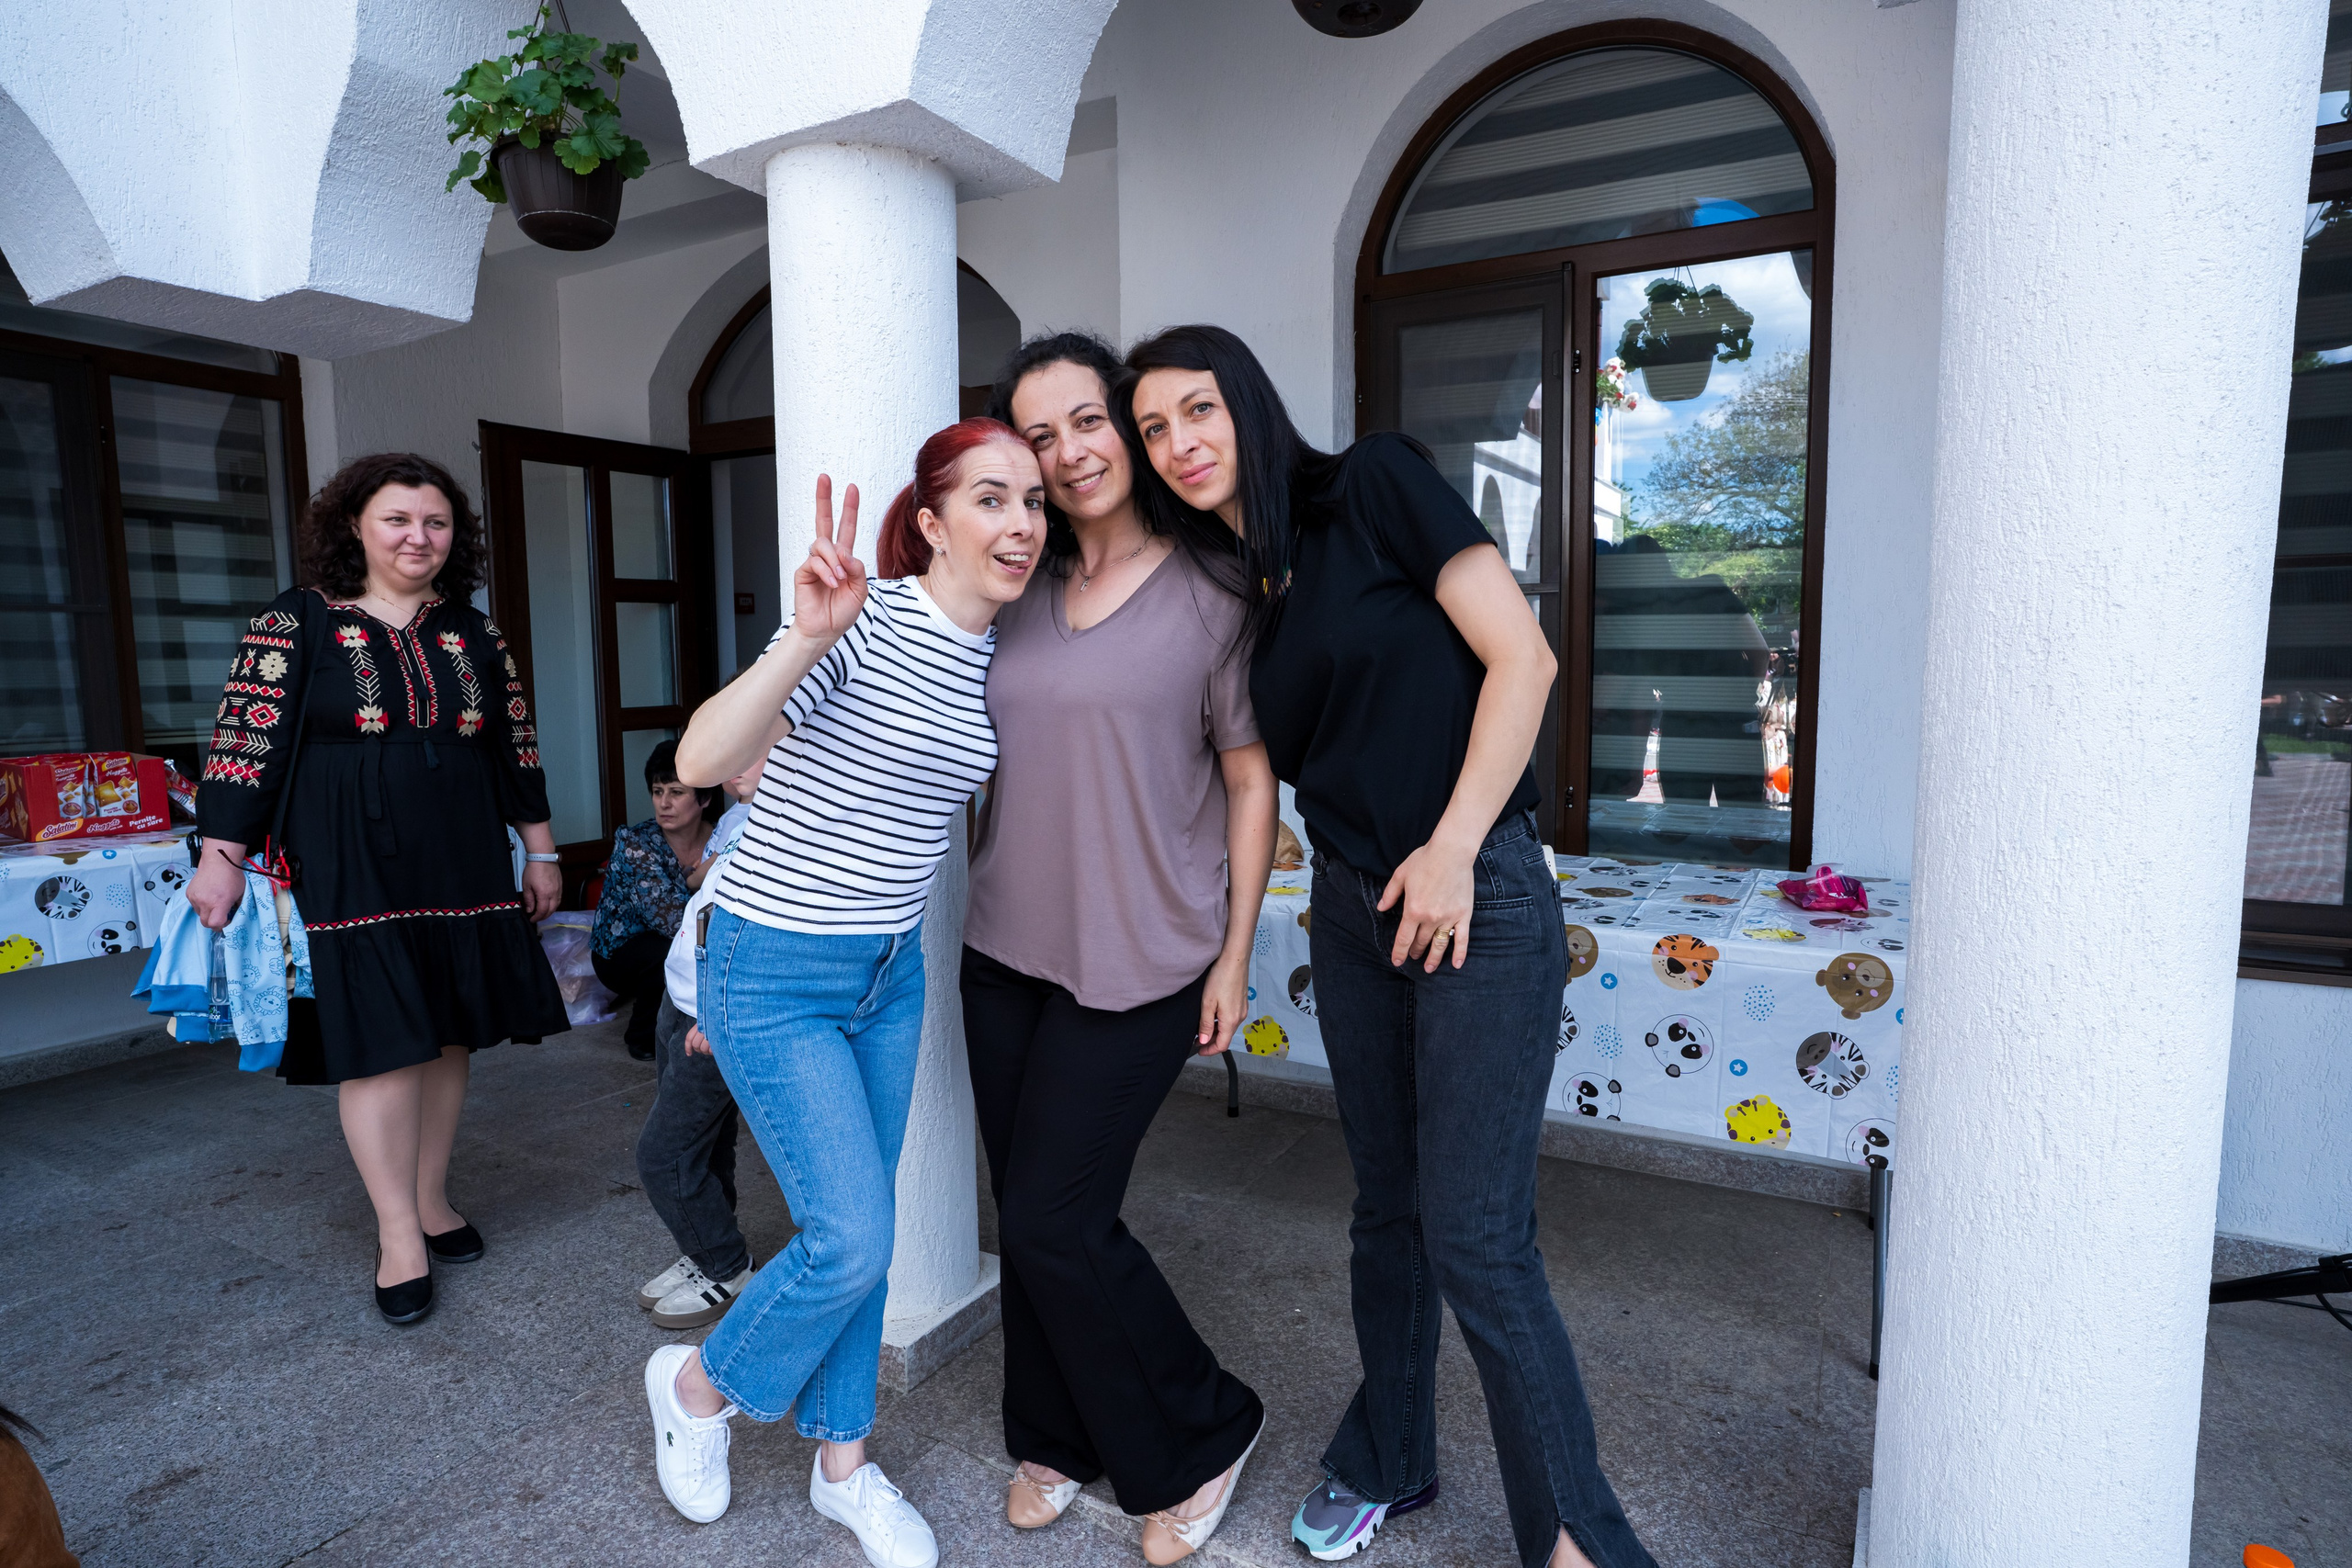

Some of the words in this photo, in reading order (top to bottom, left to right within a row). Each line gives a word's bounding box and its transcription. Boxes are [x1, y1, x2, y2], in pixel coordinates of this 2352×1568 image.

[87, 818, 120, 833] Nuggets
[147, 818, 163, 827] sare
[41, 821, 78, 839] Salatini
[257, 897, 269, 910] smile
